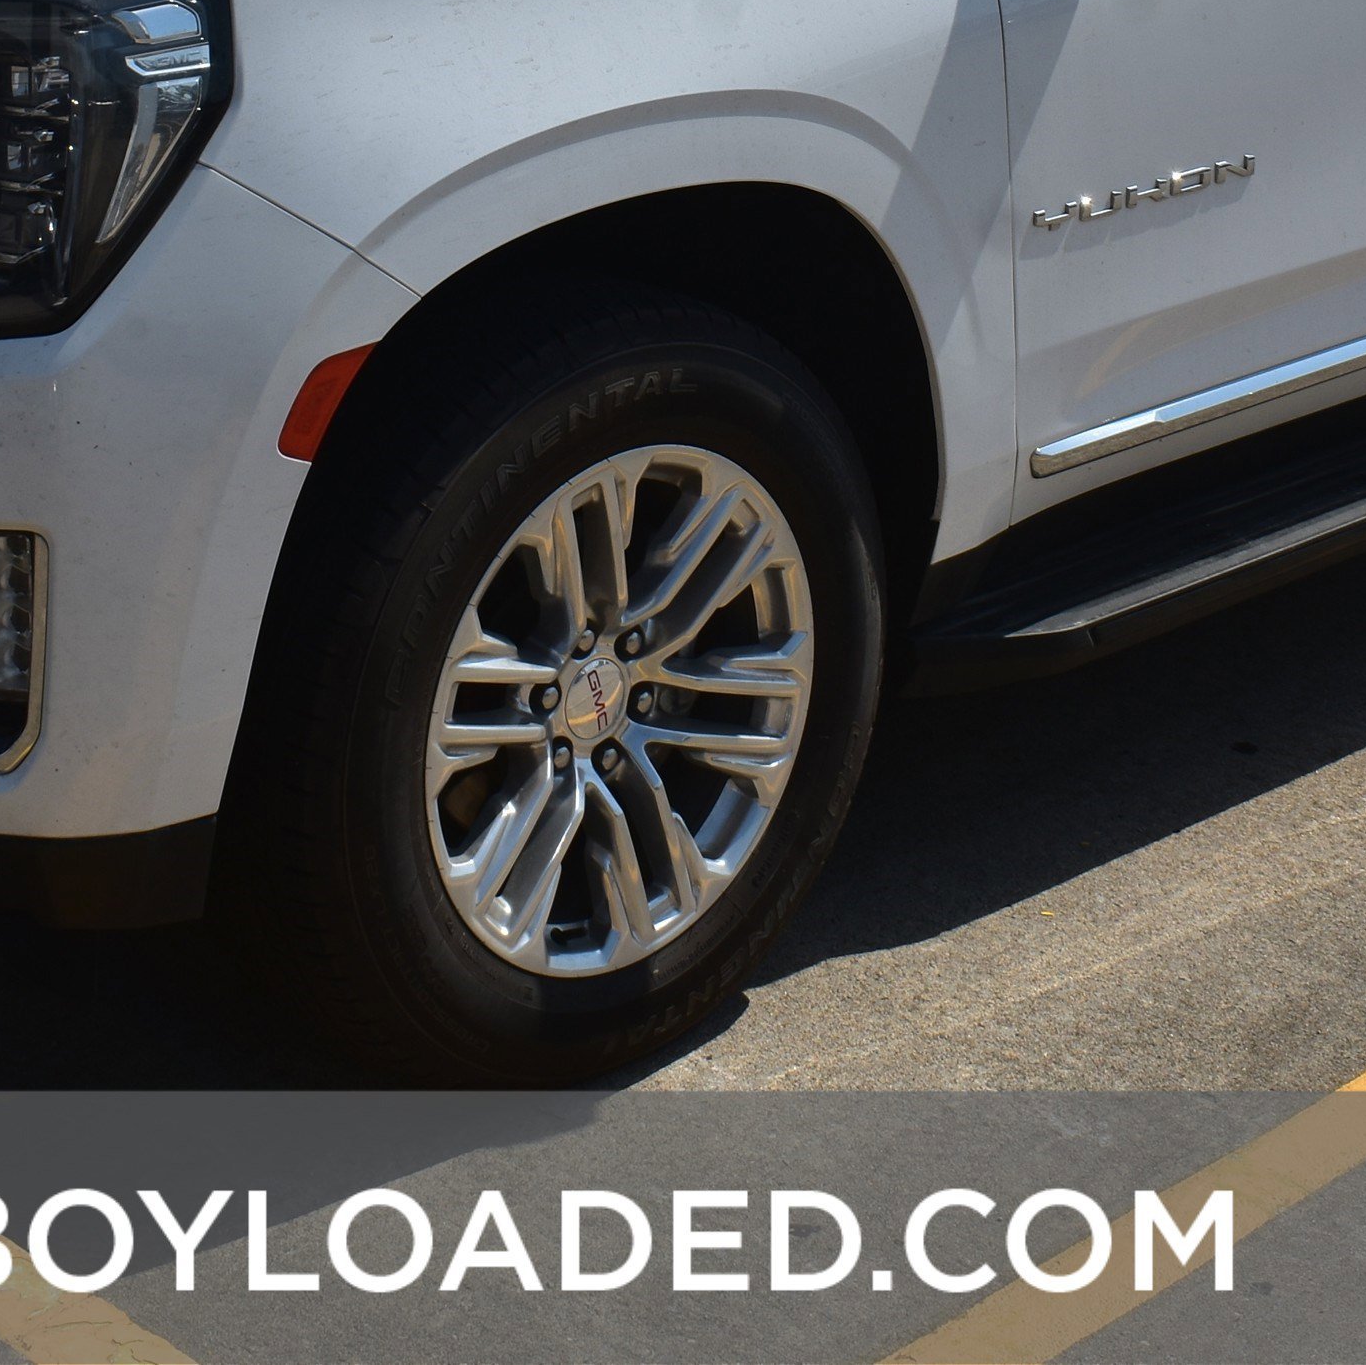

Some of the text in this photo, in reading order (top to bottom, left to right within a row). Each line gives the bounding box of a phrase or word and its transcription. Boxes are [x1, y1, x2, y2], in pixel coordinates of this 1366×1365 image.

[1033, 154, 1256, 231] YUKON
[382, 366, 701, 707] CONTINENTAL
[587, 669, 609, 732] GMC
